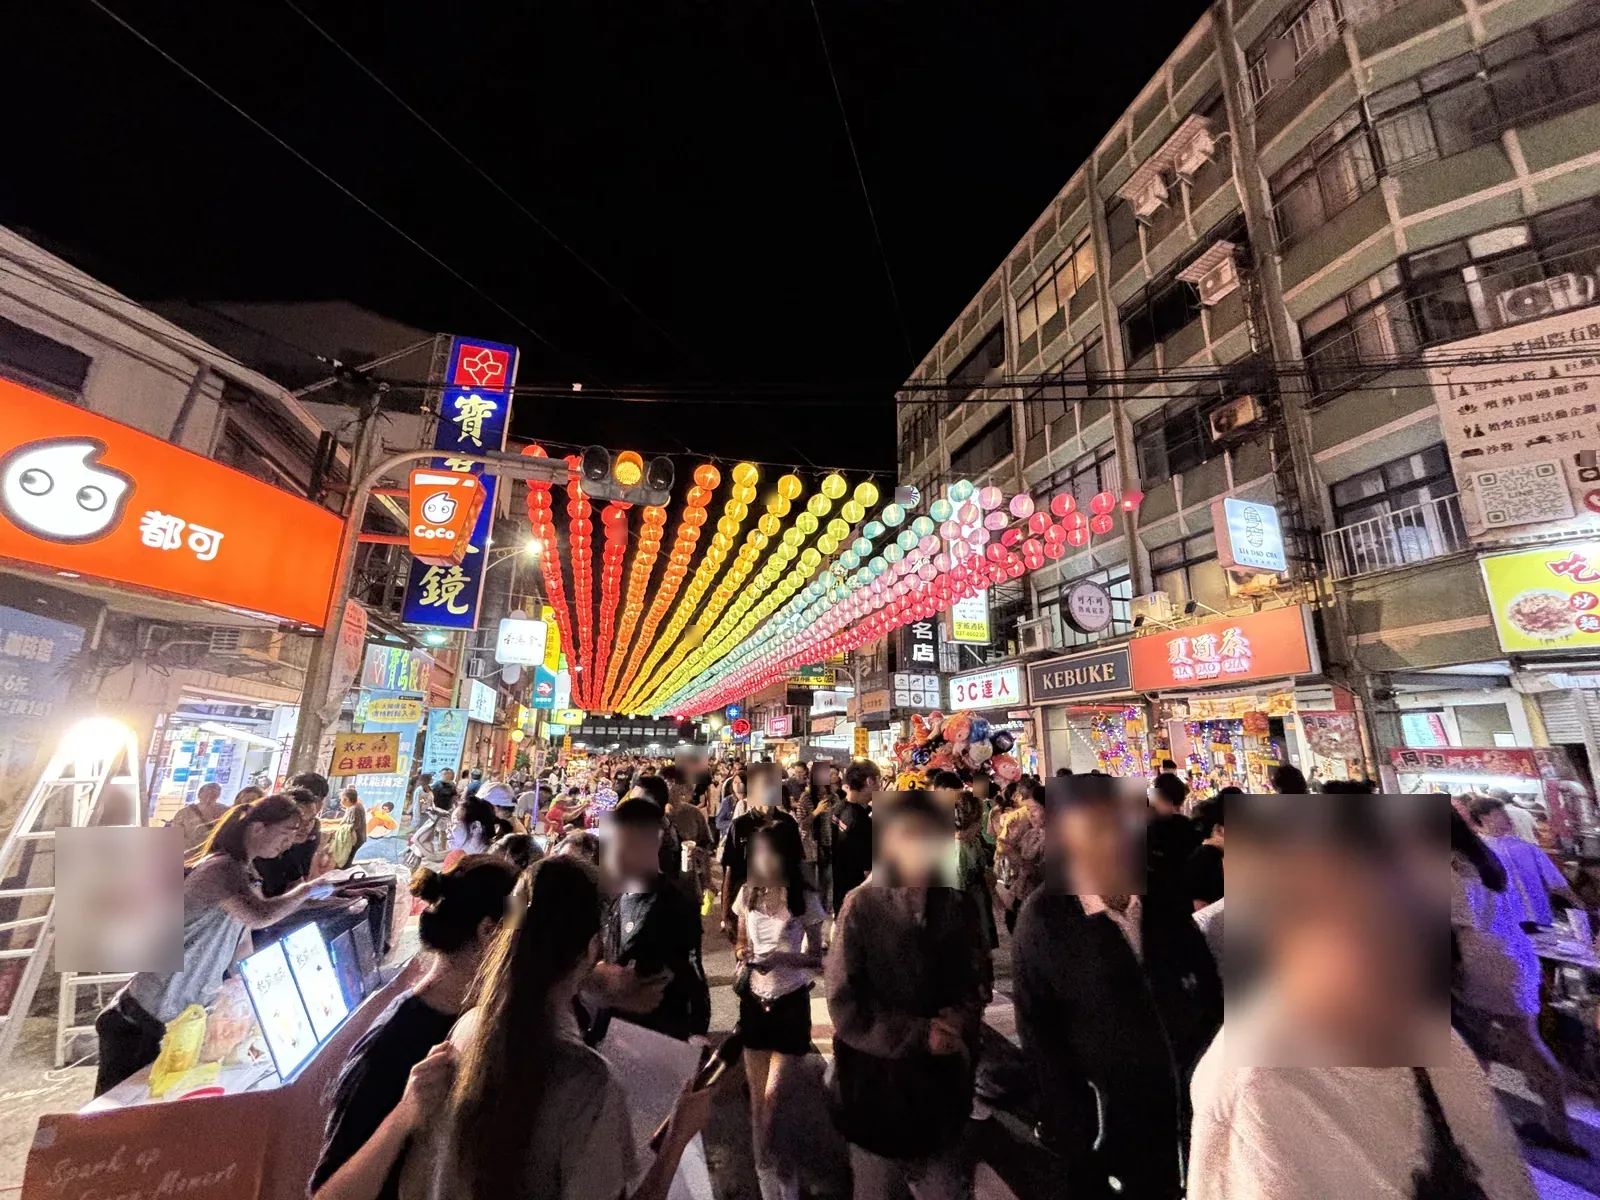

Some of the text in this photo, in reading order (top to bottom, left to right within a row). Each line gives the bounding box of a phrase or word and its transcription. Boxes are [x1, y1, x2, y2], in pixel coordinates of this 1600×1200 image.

[139, 510, 224, 561] 都可
[414, 524, 455, 540] CoCo
[1166, 627, 1252, 667] 夏道茶
[956, 676, 1010, 703] 3C達人
[1043, 663, 1115, 691] KEBUKE
